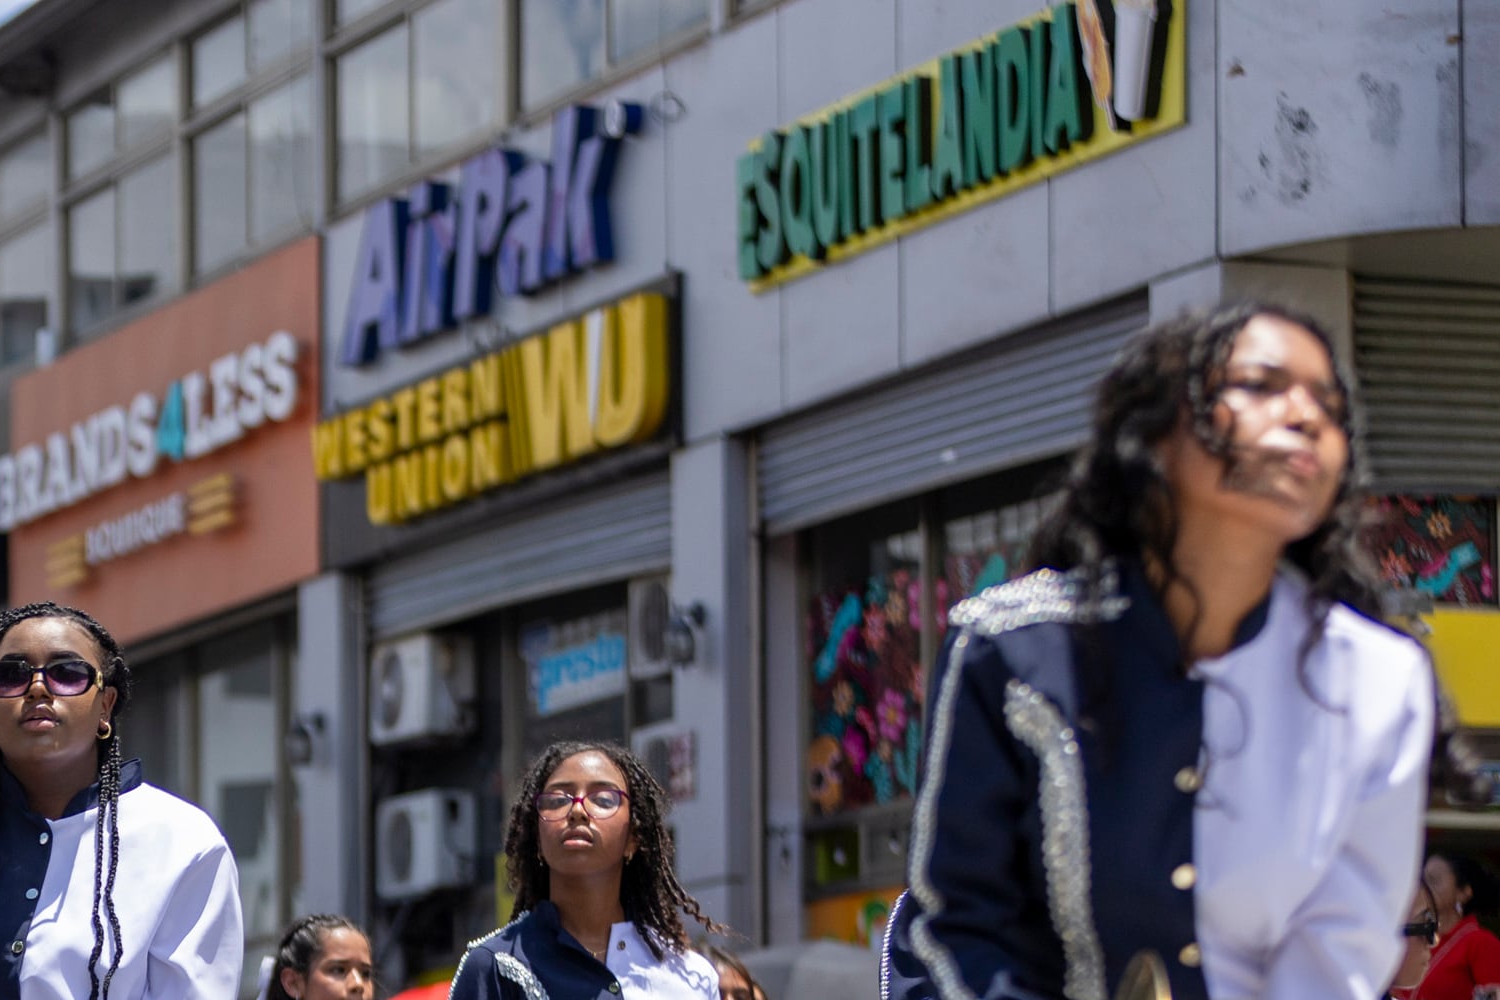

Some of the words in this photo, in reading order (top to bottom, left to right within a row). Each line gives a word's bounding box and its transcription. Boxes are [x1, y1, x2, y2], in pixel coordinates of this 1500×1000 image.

[737, 3, 1082, 281] ESQUITELANDIA
[312, 352, 503, 479] WESTERN
[521, 293, 658, 470] WU
[84, 491, 187, 566] BOUTIQUE
[367, 421, 504, 525] UNION
[538, 630, 626, 714] presto
